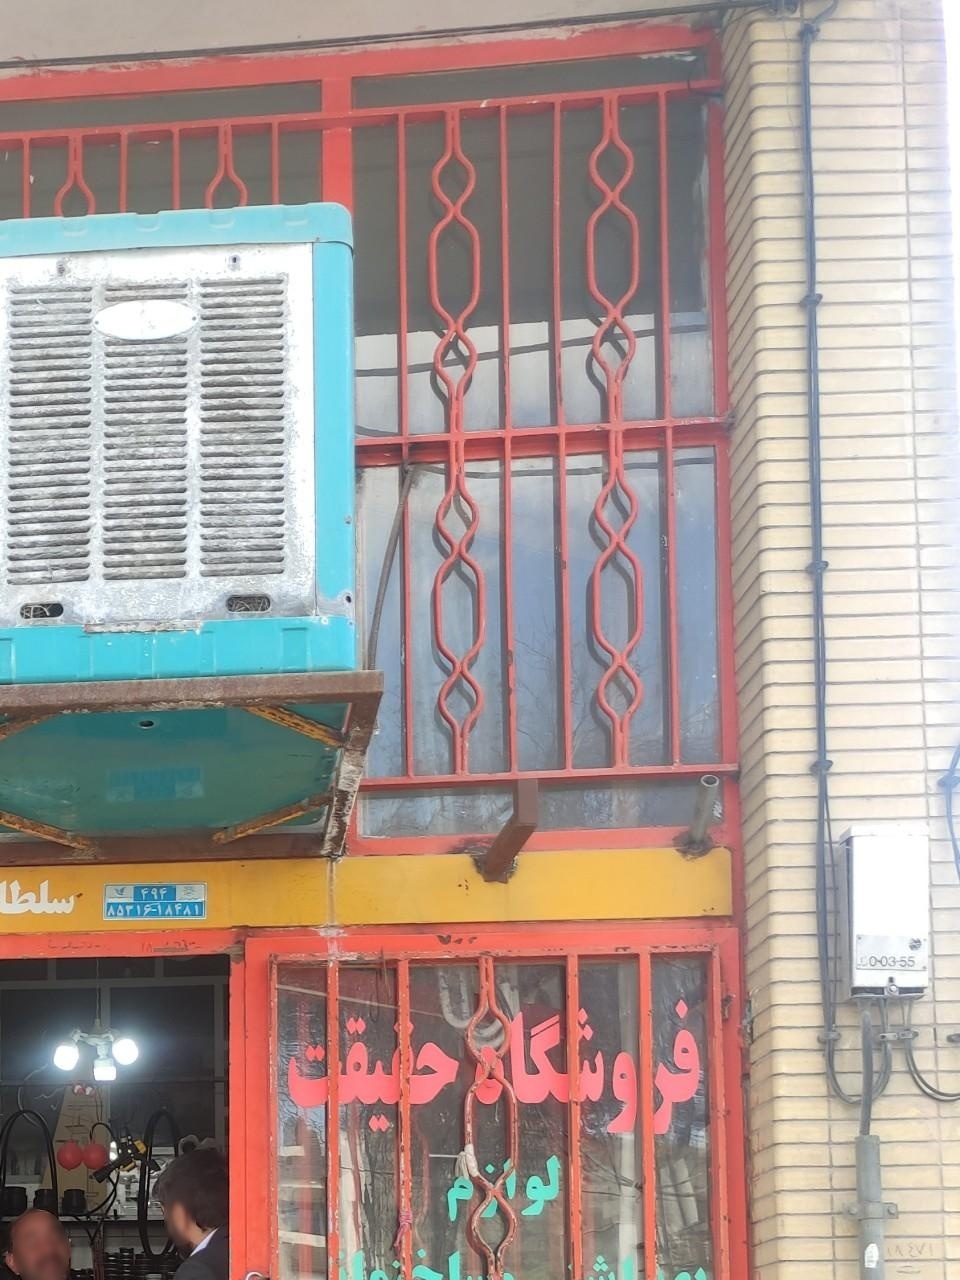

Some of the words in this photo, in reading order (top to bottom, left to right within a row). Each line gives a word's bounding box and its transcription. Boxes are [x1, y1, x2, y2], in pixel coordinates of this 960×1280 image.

[141, 887, 167, 900] ۴۹۴
[474, 1000, 700, 1134] فروشگاه
[447, 1155, 560, 1221] لوازم
